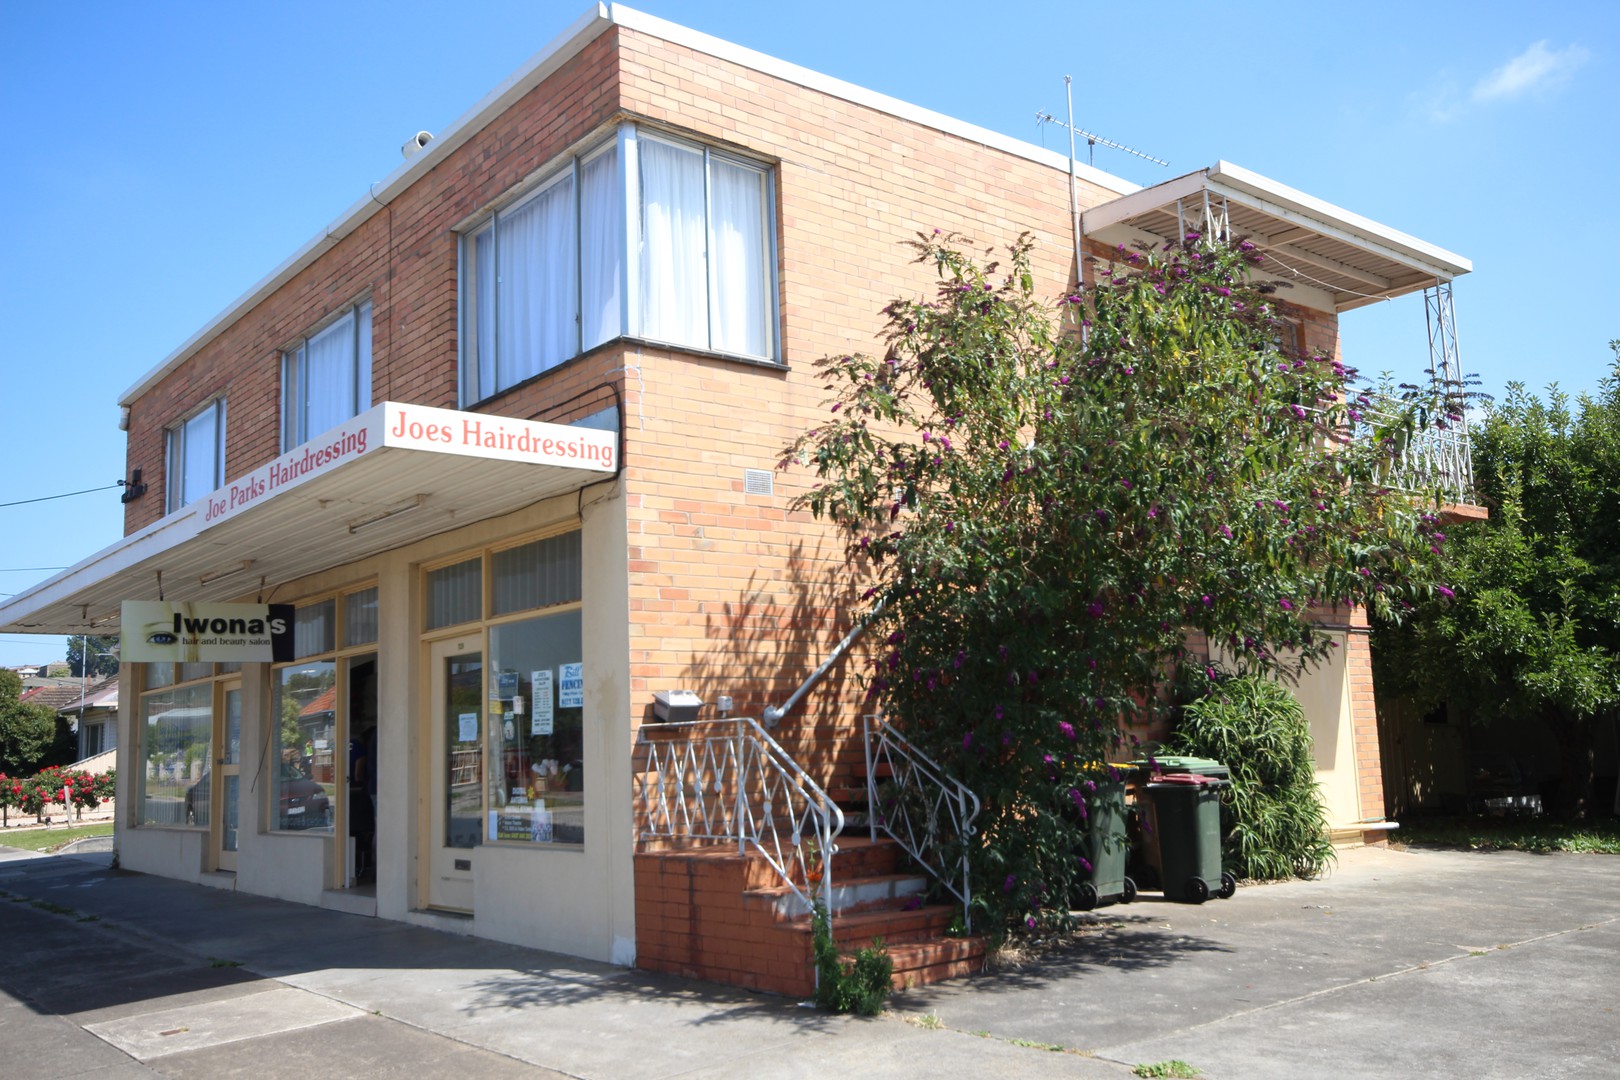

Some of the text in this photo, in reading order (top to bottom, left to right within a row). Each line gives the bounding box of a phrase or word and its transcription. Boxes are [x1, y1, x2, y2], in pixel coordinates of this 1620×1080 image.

[392, 411, 613, 467] Joes Hairdressing
[205, 427, 367, 522] Joe Parks Hairdressing
[173, 613, 287, 635] Iwona's
[182, 637, 271, 647] hair and beauty salon
